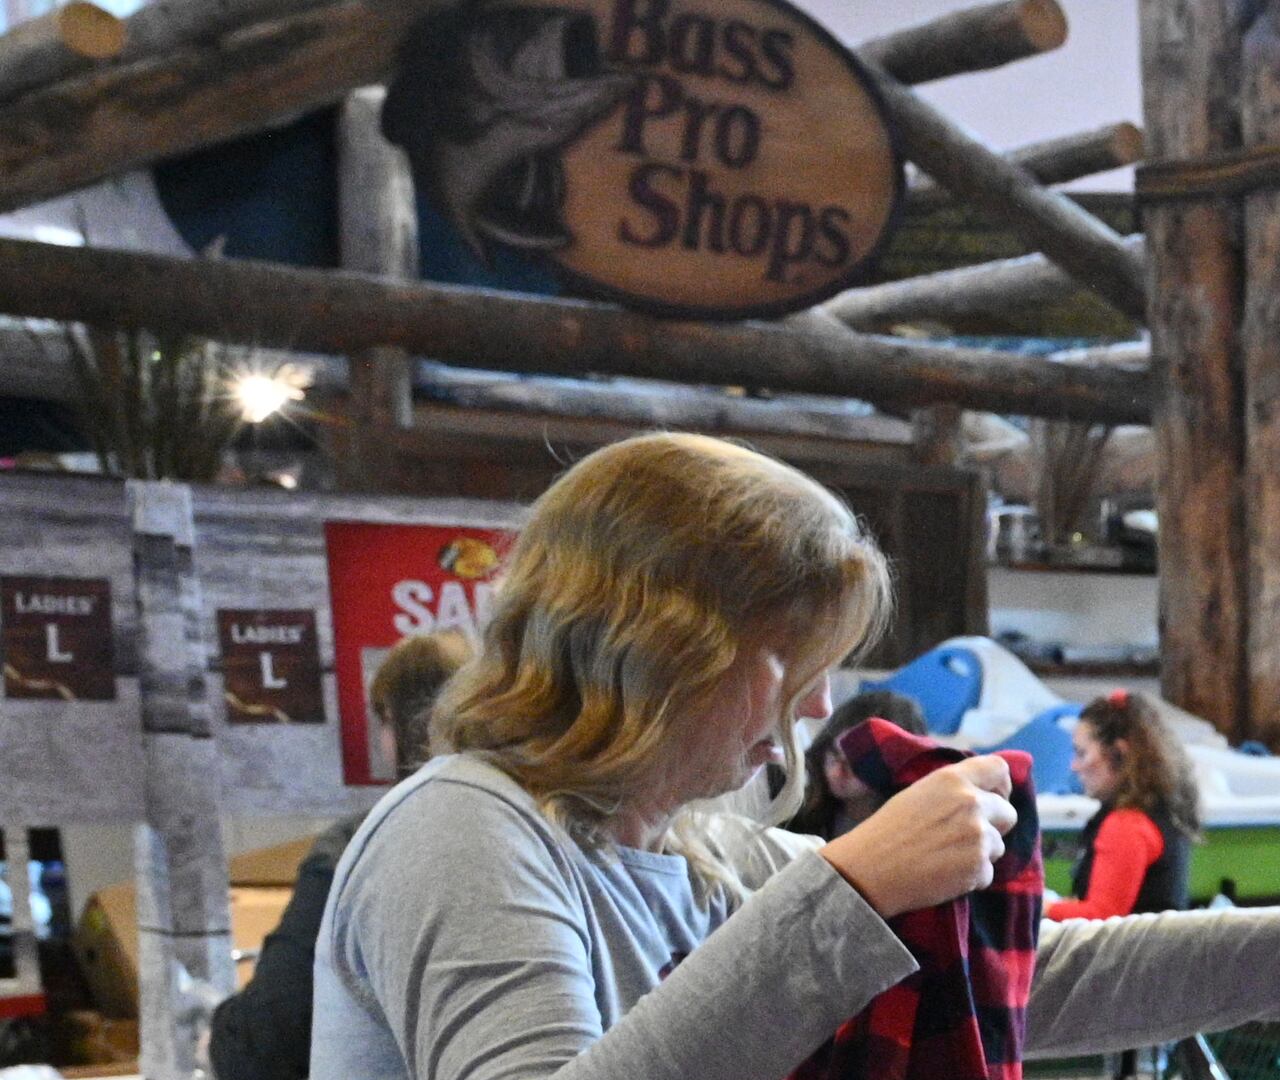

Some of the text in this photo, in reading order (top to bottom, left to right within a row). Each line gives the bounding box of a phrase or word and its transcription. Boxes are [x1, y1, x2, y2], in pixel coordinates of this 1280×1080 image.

[608, 0, 796, 91] Bass
[617, 72, 761, 170] Pro
[617, 163, 851, 282] Shops
[46, 623, 74, 663] L
[259, 652, 287, 689] L
